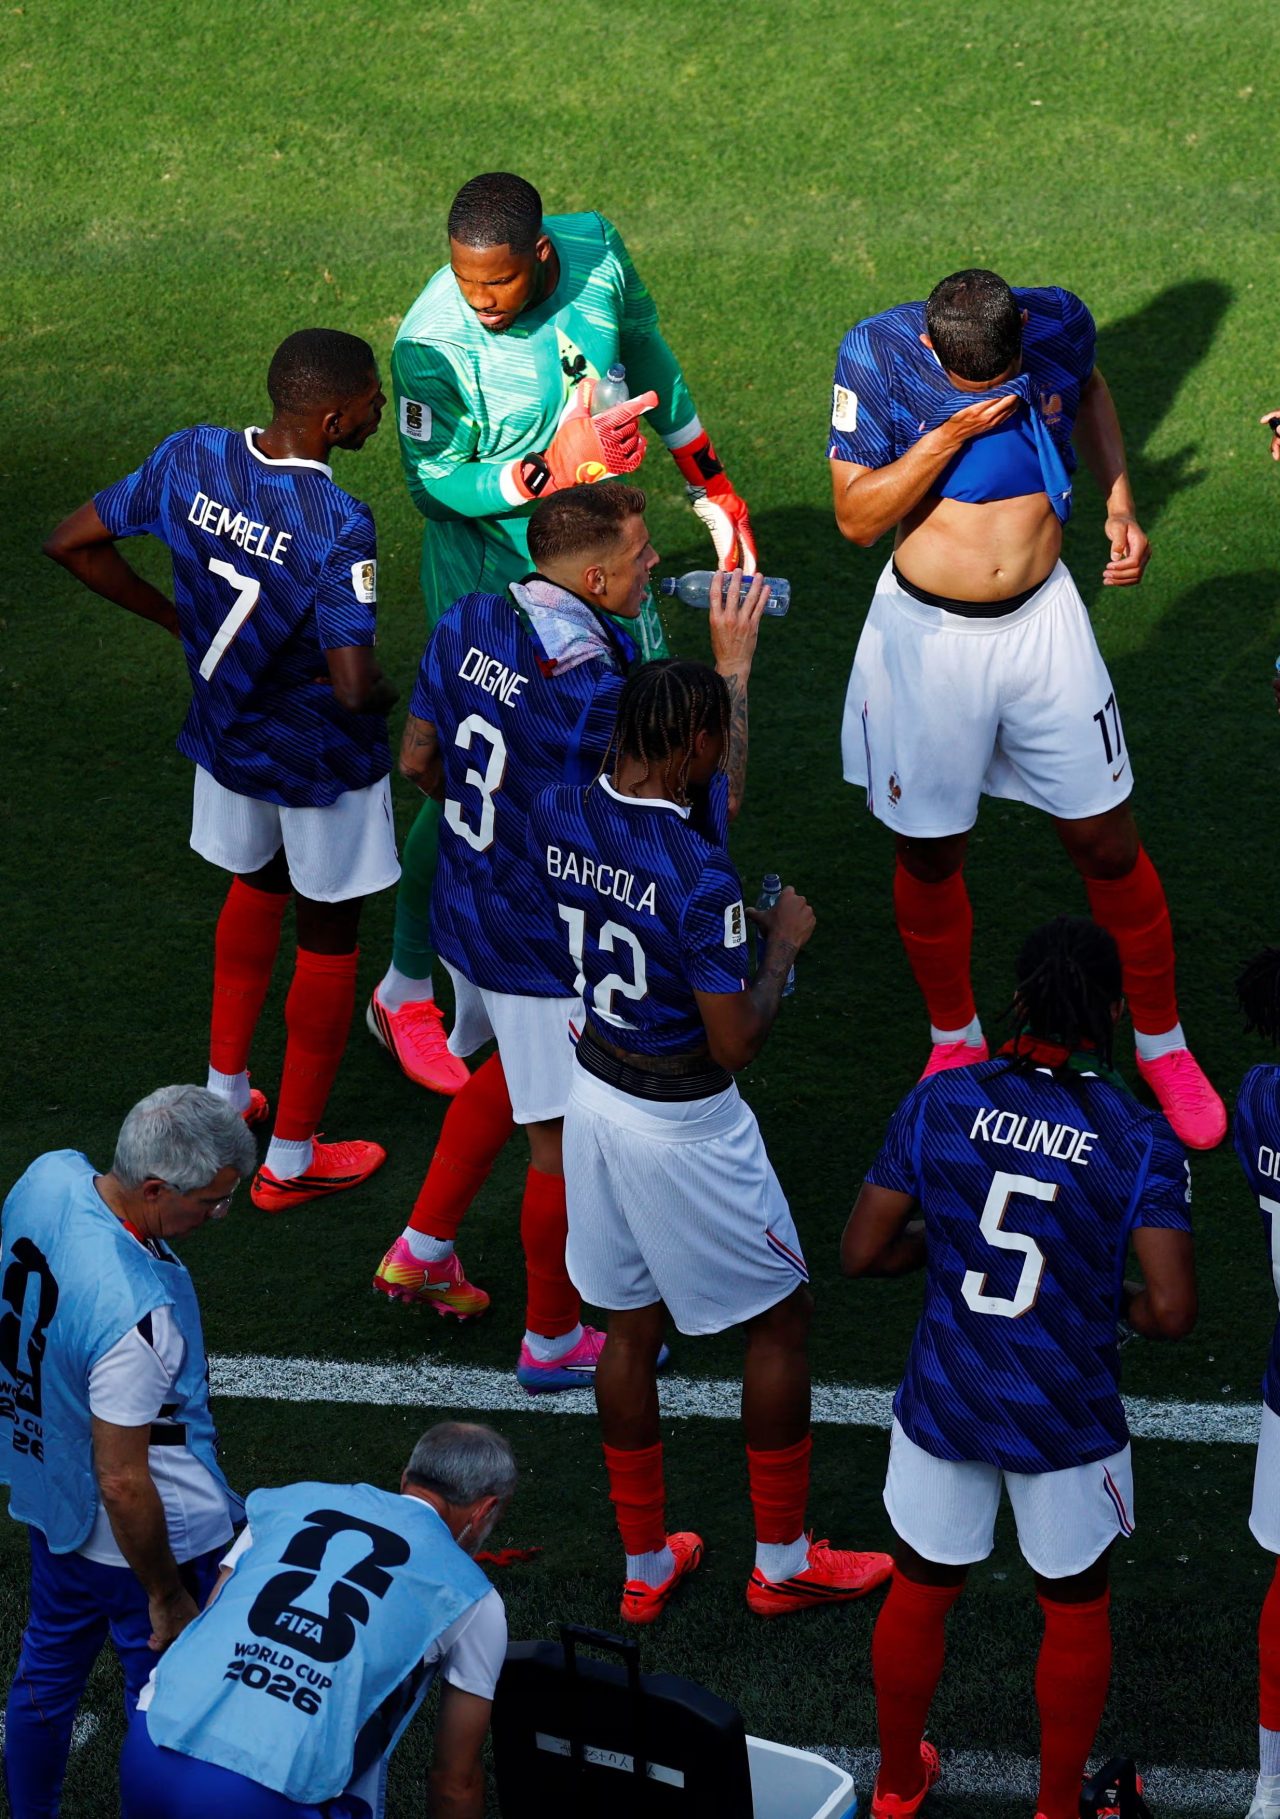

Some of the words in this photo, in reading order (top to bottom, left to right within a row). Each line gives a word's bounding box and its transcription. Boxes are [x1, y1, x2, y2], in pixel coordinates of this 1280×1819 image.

[188, 491, 292, 566] DEMBELE
[199, 557, 261, 681] 7
[458, 646, 529, 709] DIGNE
[1093, 692, 1122, 765] 17
[444, 713, 508, 852] 3
[547, 845, 656, 916] BARCOLA
[557, 902, 648, 1031] 12
[969, 1107, 1099, 1166] KOUNDE
[960, 1170, 1059, 1319] 5
[274, 1611, 325, 1645] FIFA
[222, 1658, 323, 1717] 2026
[233, 1641, 294, 1671] WORLD
[295, 1663, 333, 1690] CUP
